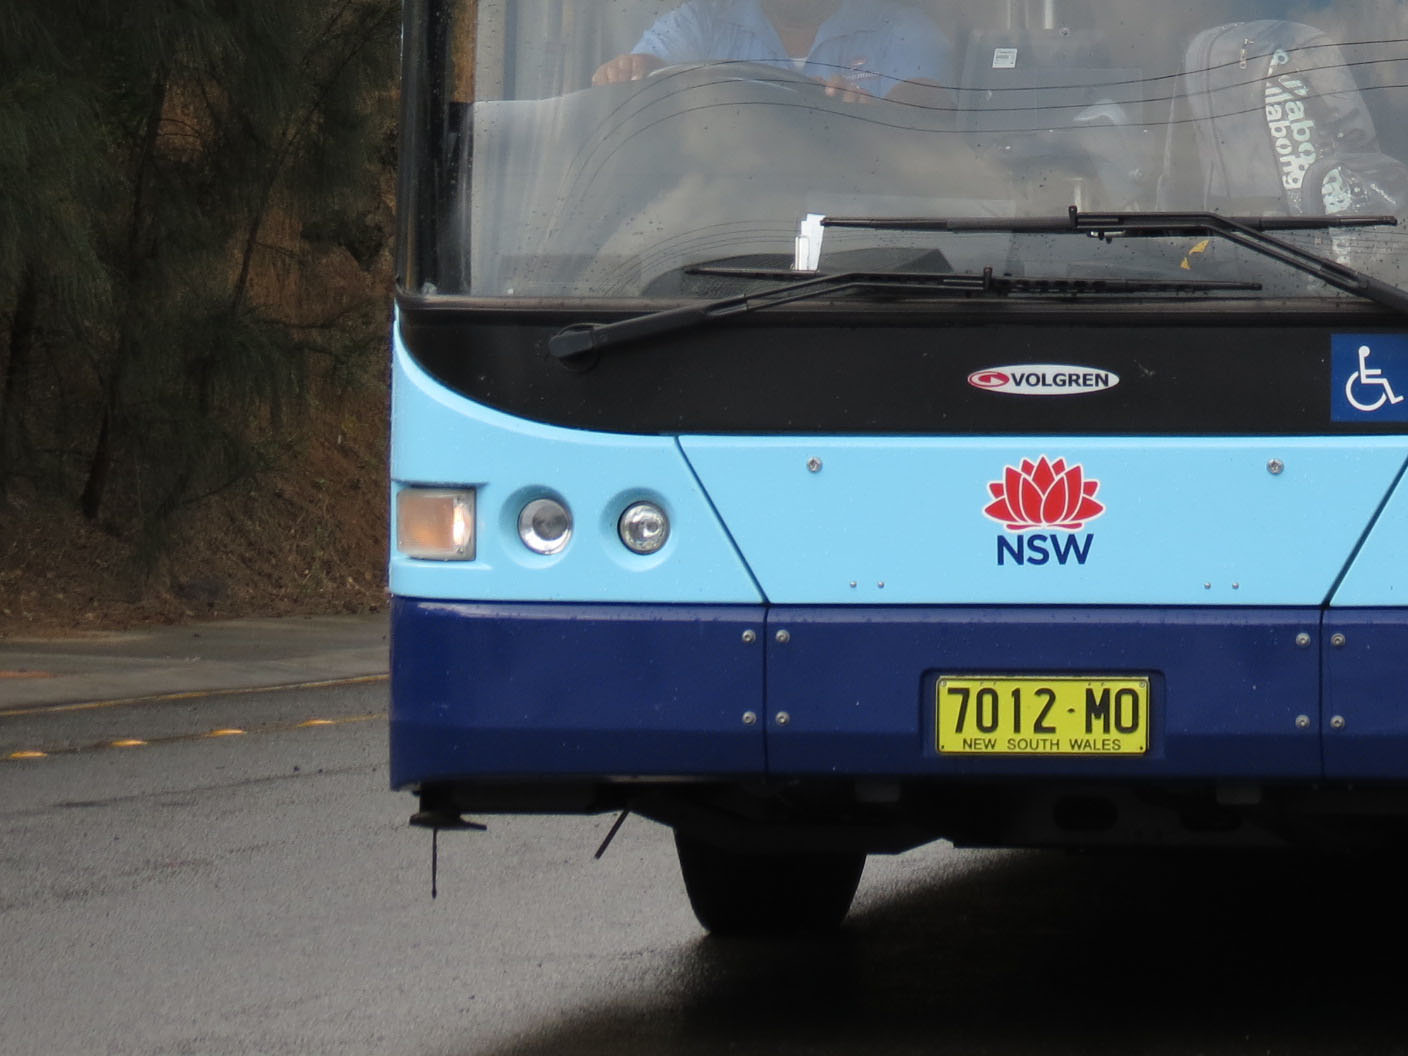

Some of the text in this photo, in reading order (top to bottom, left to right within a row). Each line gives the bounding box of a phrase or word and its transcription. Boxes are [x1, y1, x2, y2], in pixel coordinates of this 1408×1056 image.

[1010, 372, 1109, 387] VOLGREN
[996, 533, 1094, 566] NSW
[962, 738, 1122, 751] NEW SOUTH WALES
